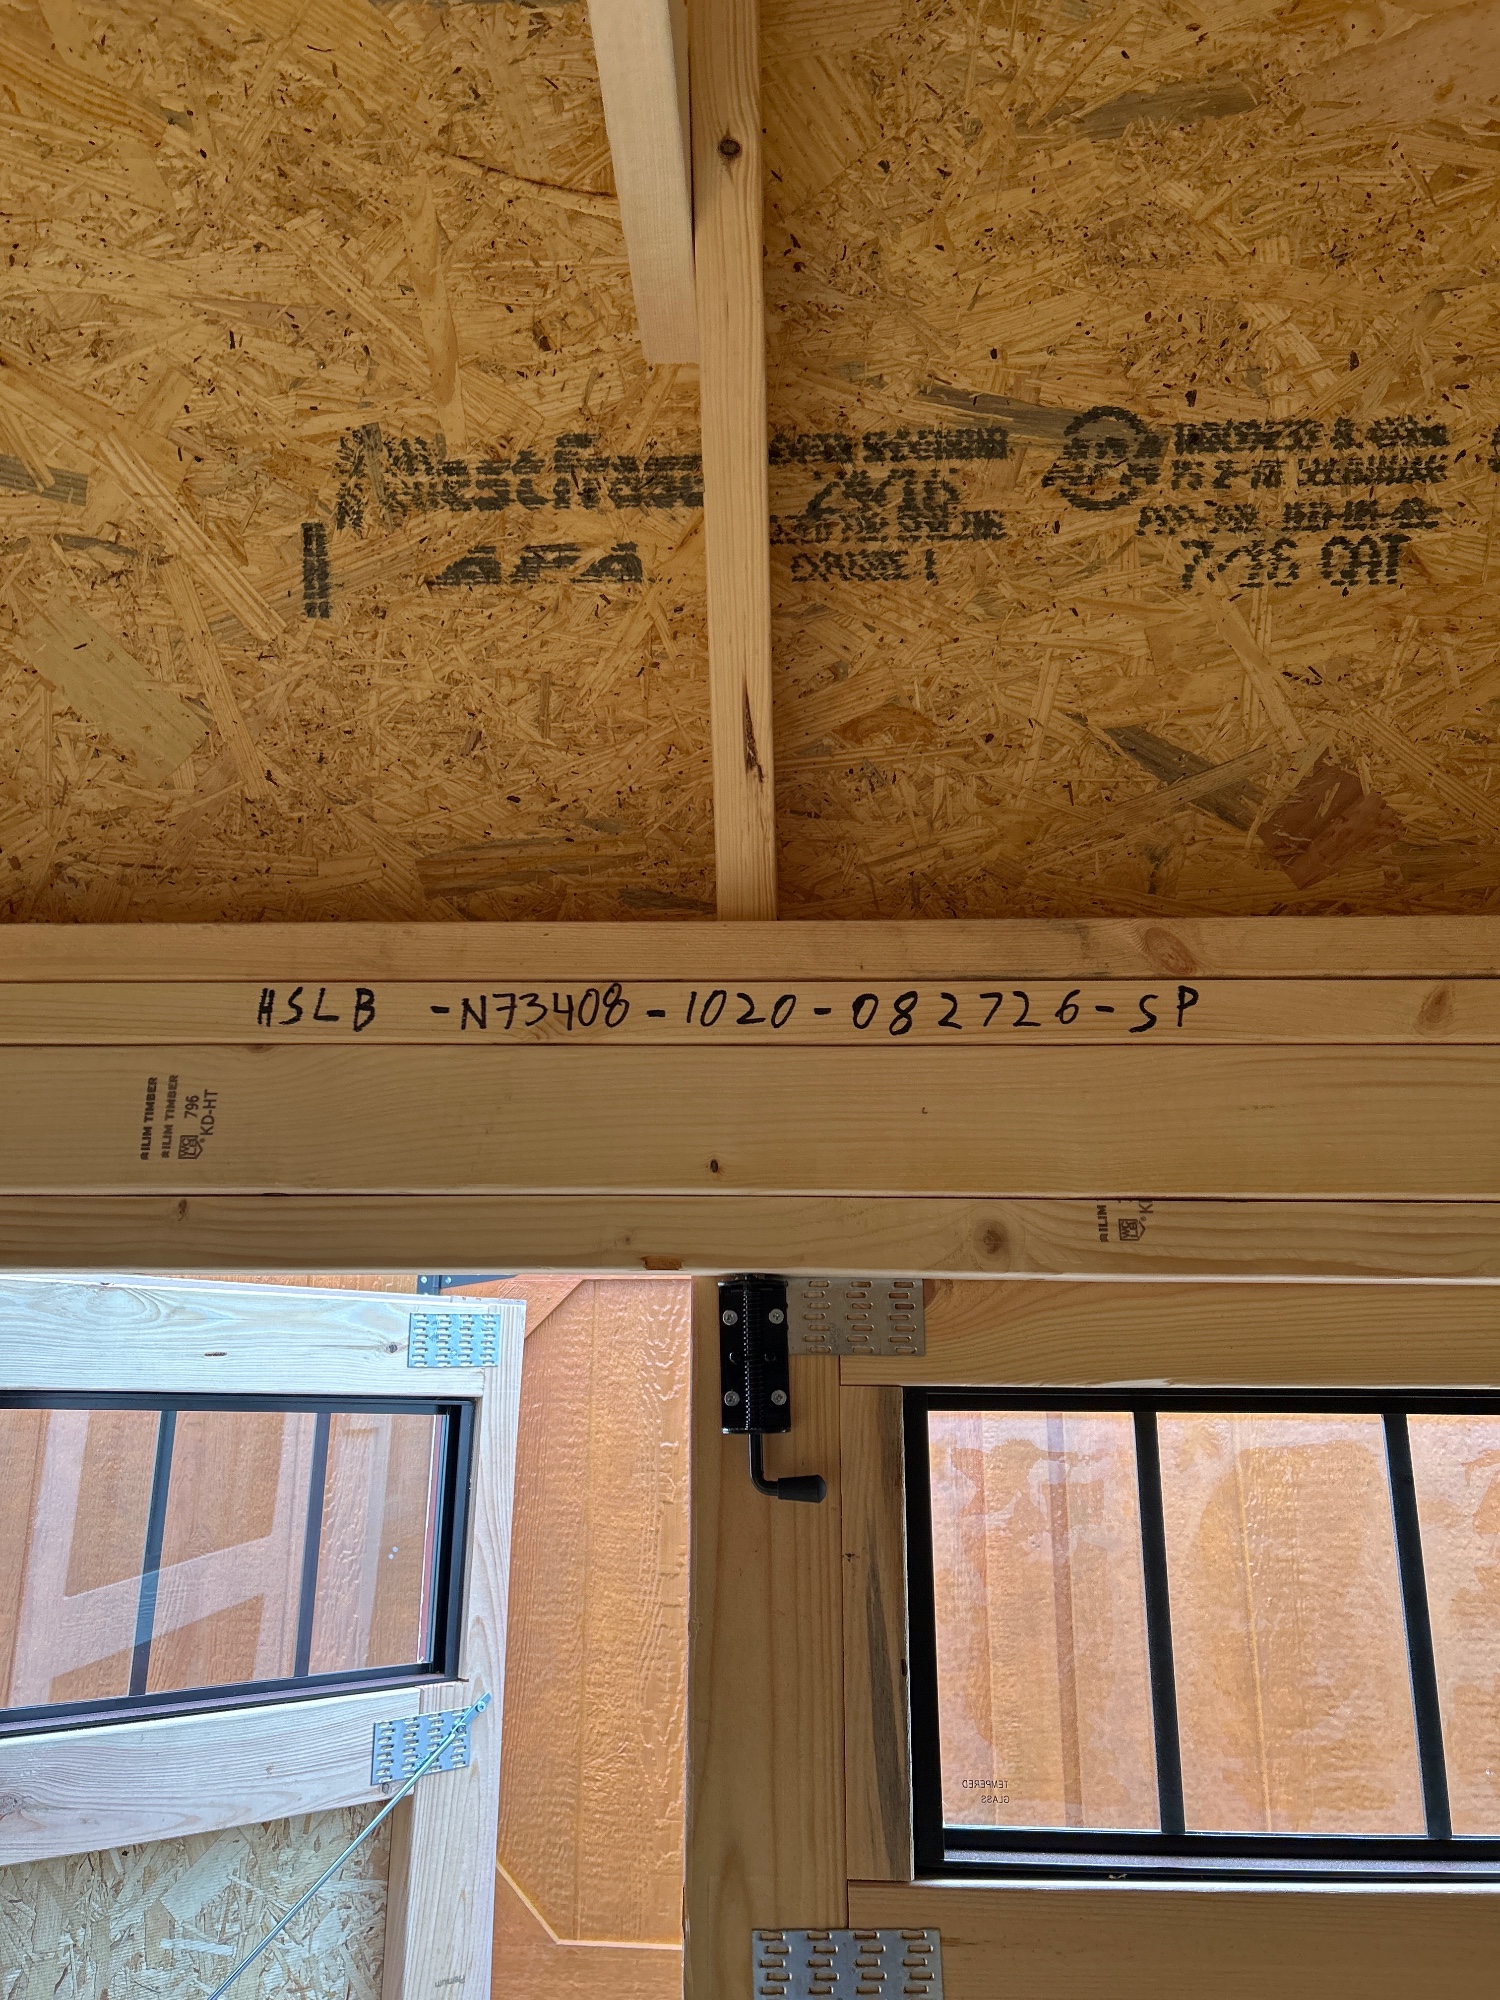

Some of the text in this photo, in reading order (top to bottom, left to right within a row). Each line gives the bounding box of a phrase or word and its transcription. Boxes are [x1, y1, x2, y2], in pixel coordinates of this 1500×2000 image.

[255, 985, 376, 1032] HSLB
[143, 1076, 158, 1123] TIMBER
[164, 1074, 179, 1121] TIMBER
[183, 1094, 200, 1119] 796
[199, 1088, 219, 1136] KD-HT
